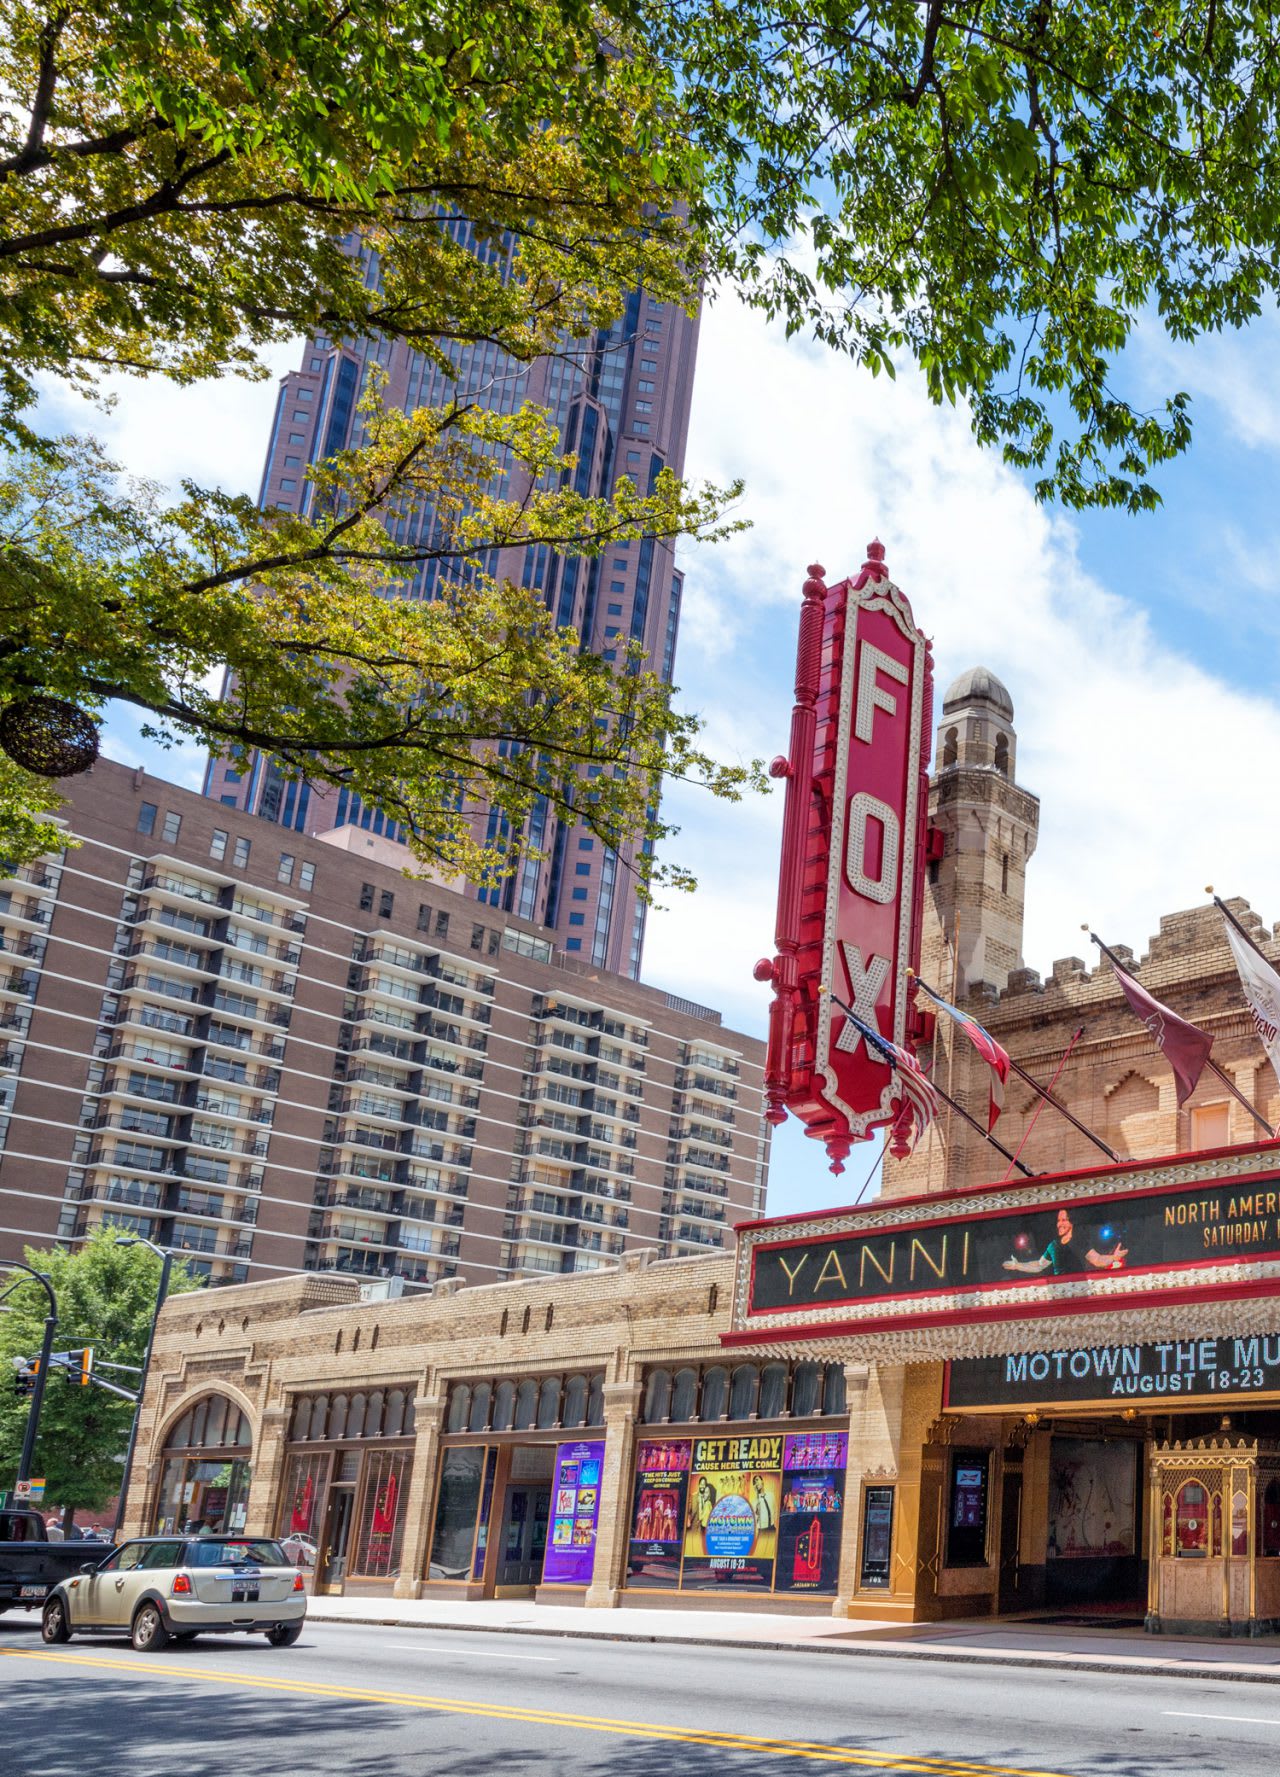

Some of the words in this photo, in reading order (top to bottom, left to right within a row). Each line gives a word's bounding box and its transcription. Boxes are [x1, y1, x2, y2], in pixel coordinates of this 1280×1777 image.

[835, 639, 909, 1065] FOX
[1164, 1199, 1220, 1227] NORTH
[779, 1231, 969, 1297] YANNI
[1005, 1346, 1142, 1383] MOTOWN
[1154, 1339, 1218, 1372] THE
[1111, 1372, 1196, 1396] AUGUST
[1207, 1368, 1266, 1390] 18-23
[696, 1440, 727, 1462] GET
[728, 1438, 782, 1461] READY,
[720, 1461, 740, 1470] HERE
[741, 1461, 754, 1469] WE
[708, 1514, 754, 1527] MOTOWN
[709, 1558, 730, 1569] AUGUST
